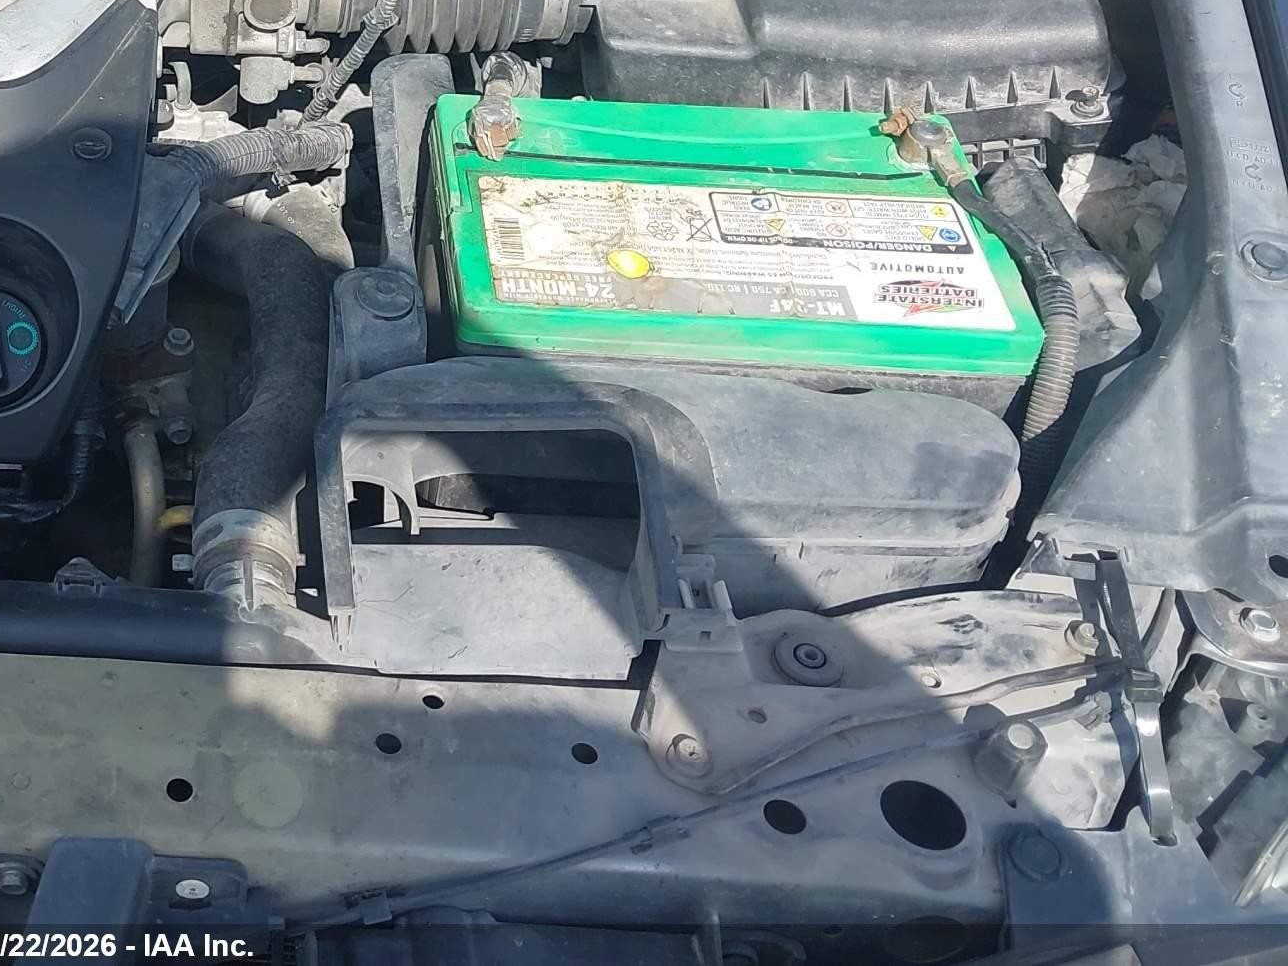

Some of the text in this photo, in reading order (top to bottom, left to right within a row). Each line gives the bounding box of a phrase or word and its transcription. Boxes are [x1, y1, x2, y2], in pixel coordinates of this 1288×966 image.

[823, 240, 933, 252] DANGER/POISON
[869, 261, 965, 274] AUTOMOTIVE
[583, 275, 612, 284] FREE
[502, 279, 615, 299] 24-MONTH
[727, 284, 742, 293] RC
[752, 285, 772, 295] 750
[818, 289, 839, 298] CCA
[880, 285, 976, 298] BATTERIES
[877, 294, 983, 308] INTERSTATE
